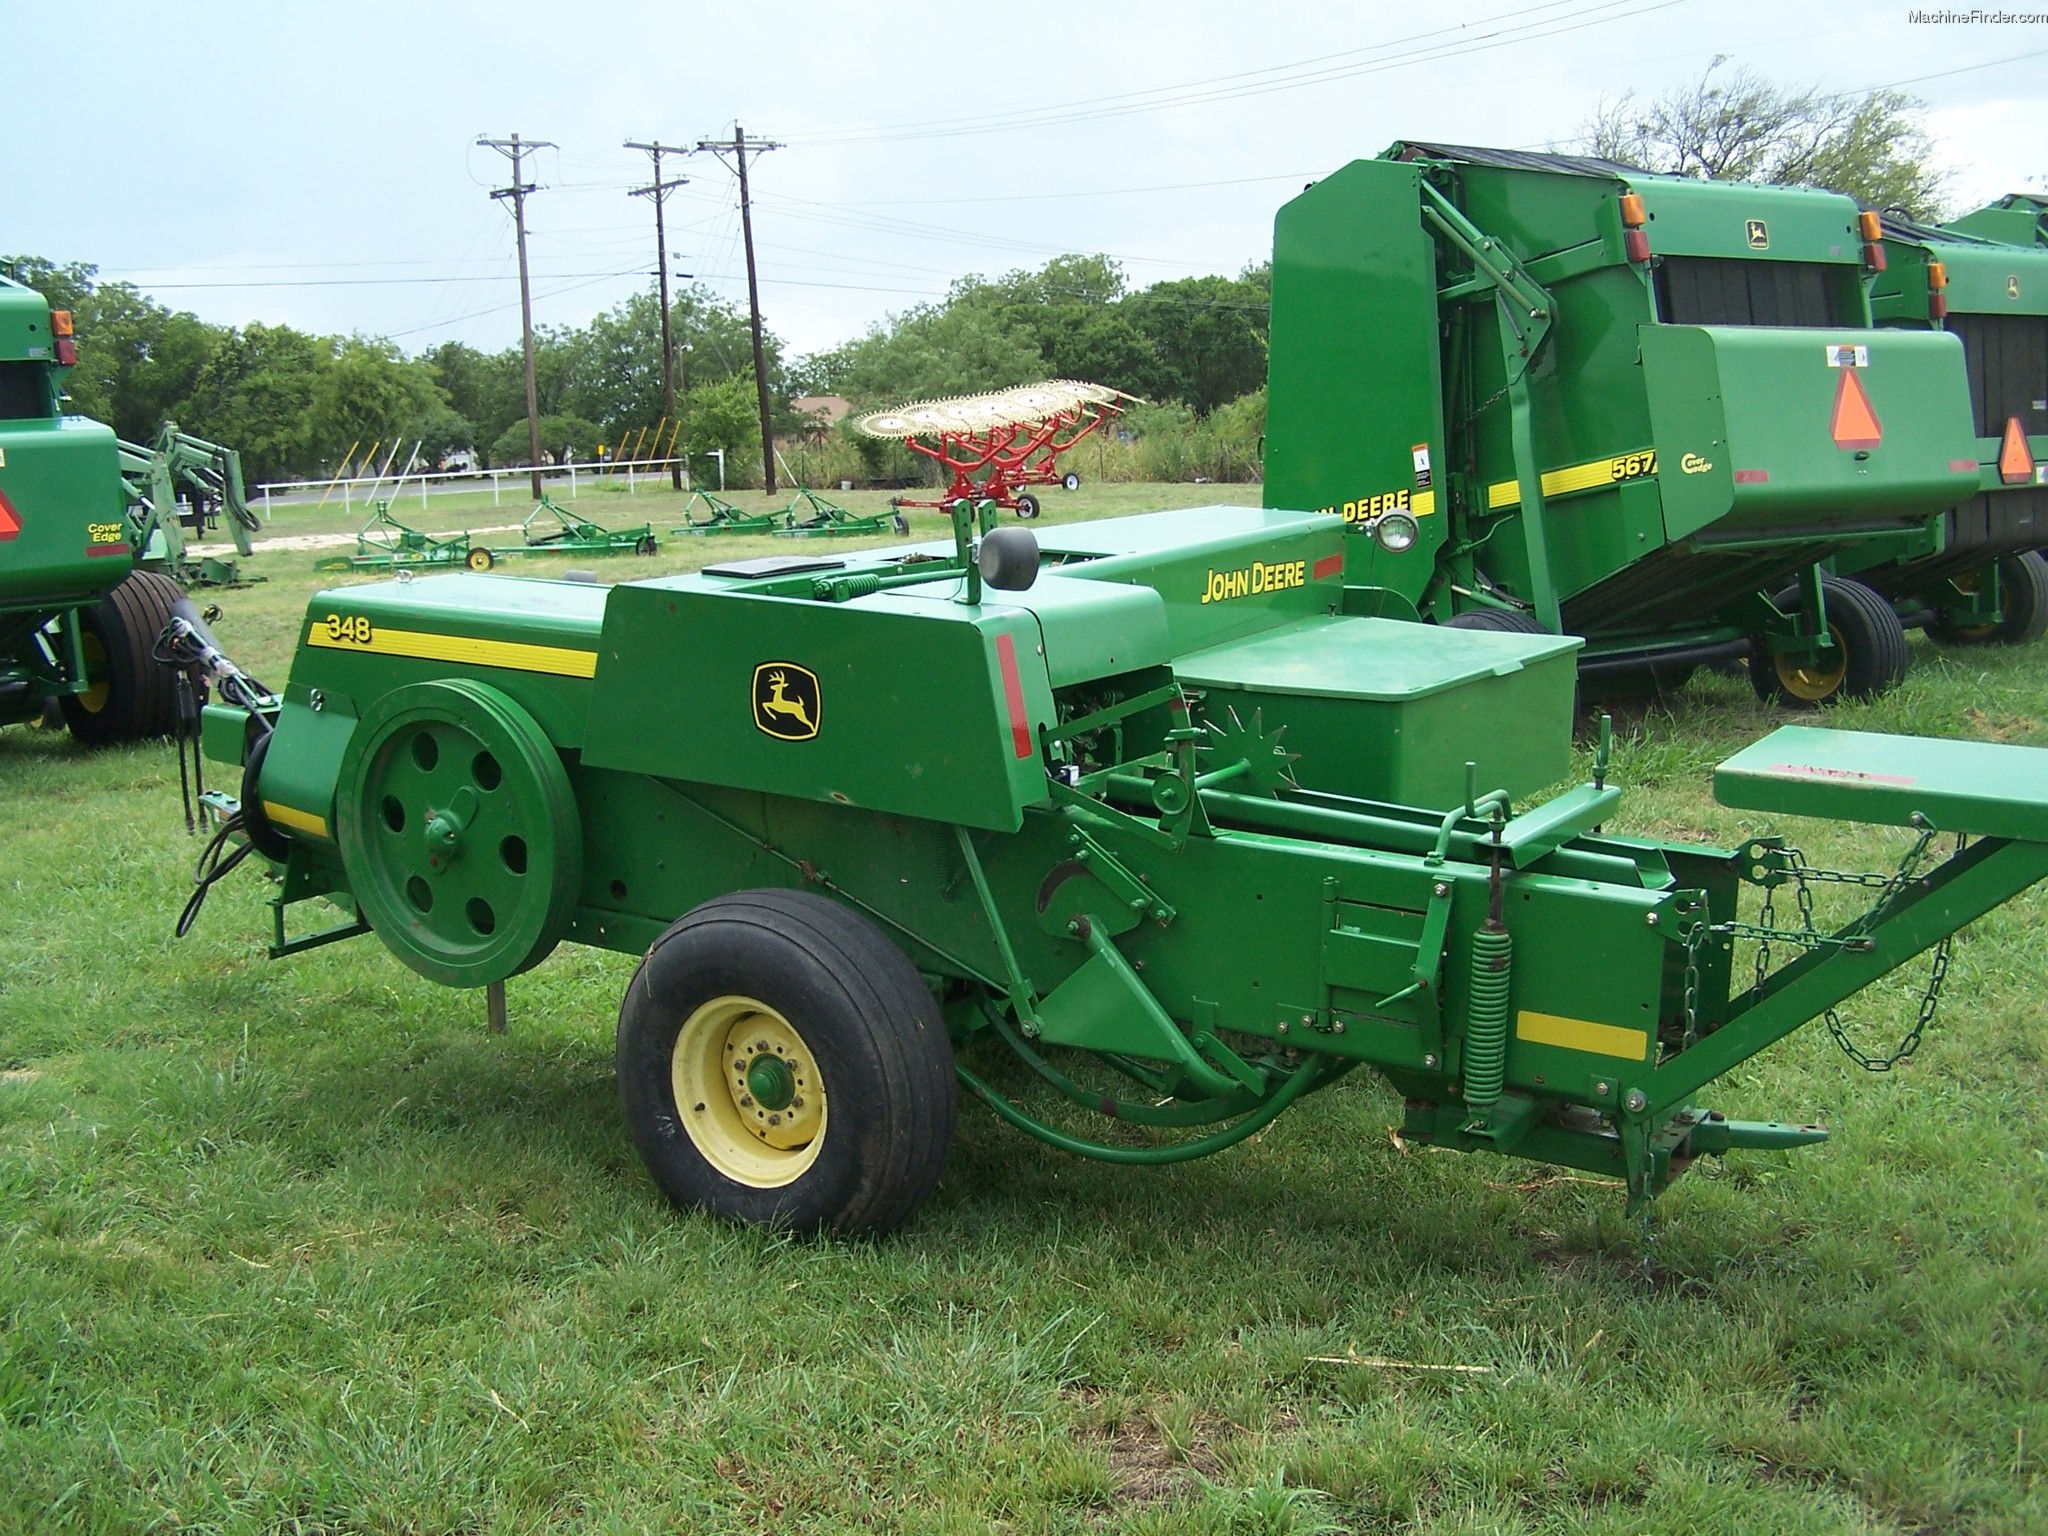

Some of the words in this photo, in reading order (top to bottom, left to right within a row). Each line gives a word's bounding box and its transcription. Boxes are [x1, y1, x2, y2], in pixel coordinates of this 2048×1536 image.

[1612, 451, 1656, 480] 567
[1342, 489, 1410, 524] DEERE
[88, 523, 123, 533] Cover
[92, 532, 122, 543] Edge
[1201, 568, 1249, 604] JOHN
[1251, 561, 1305, 595] DEERE
[326, 613, 372, 643] 348
